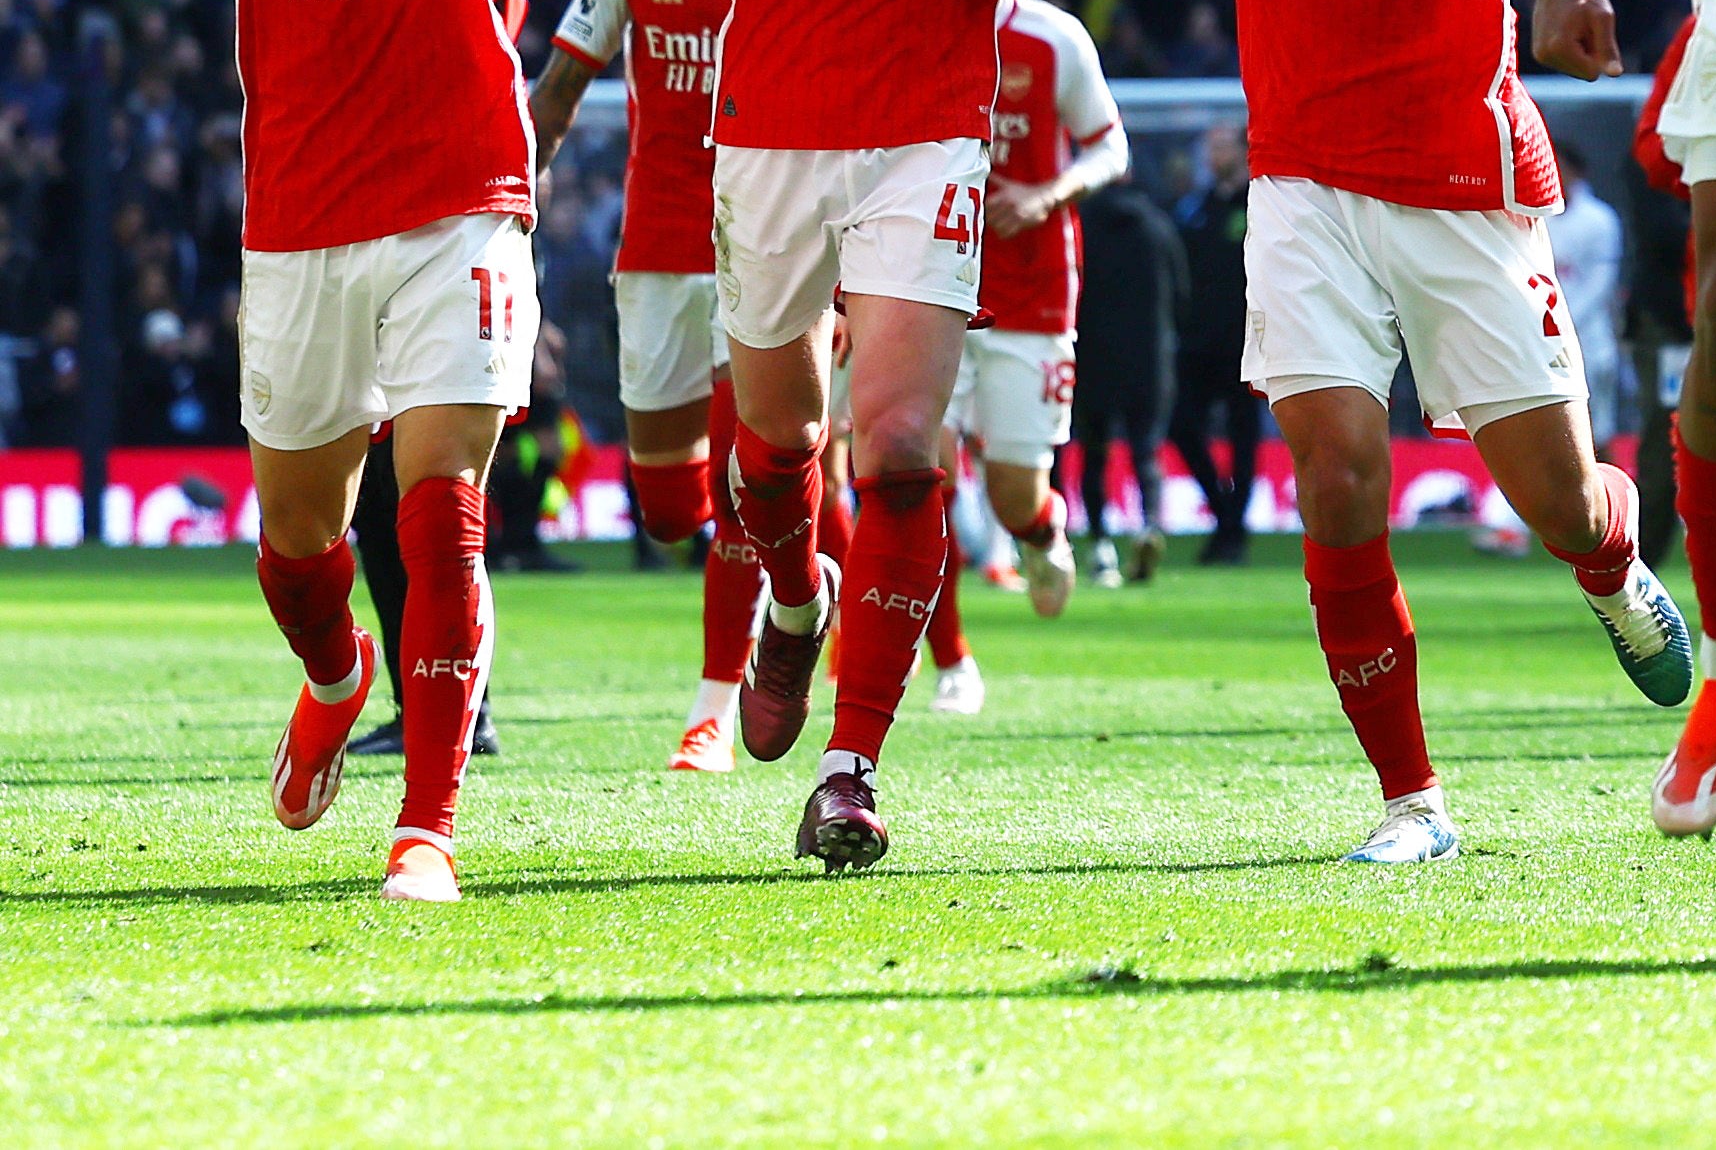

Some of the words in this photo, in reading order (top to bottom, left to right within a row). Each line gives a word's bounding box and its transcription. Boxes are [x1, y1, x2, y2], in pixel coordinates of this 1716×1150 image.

[665, 62, 698, 93] FLY
[934, 183, 982, 258] 41
[1041, 359, 1078, 406] 18
[713, 538, 758, 564] AFC
[860, 586, 927, 621] AFC
[411, 657, 473, 682] AFC
[1336, 647, 1398, 688] AFC
